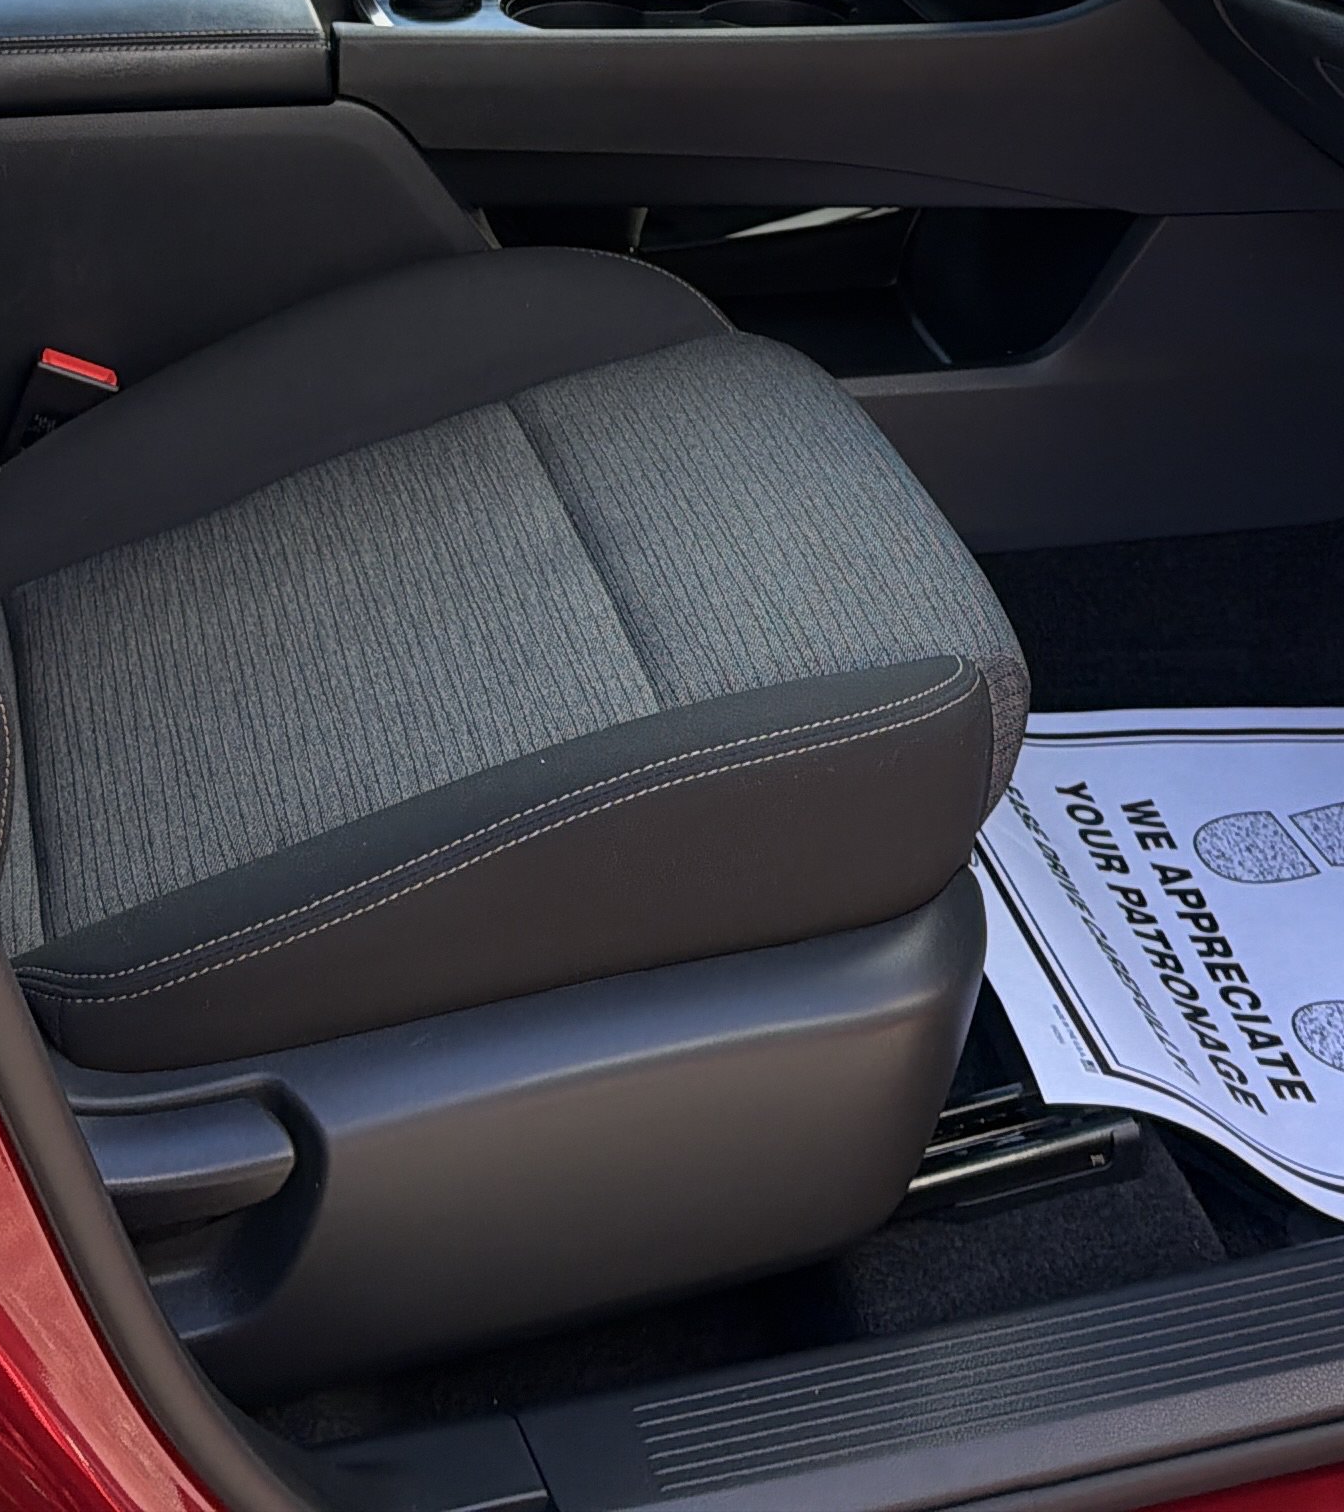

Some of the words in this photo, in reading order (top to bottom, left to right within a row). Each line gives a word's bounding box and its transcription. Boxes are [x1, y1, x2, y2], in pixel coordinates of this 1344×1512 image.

[1005, 785, 1050, 843] EASE
[1032, 836, 1096, 921] DRIVE
[1054, 781, 1130, 875] YOUR
[1106, 882, 1269, 1116] PATRONAGE
[1120, 798, 1179, 851] WE
[1150, 861, 1317, 1104] APPRECIATE
